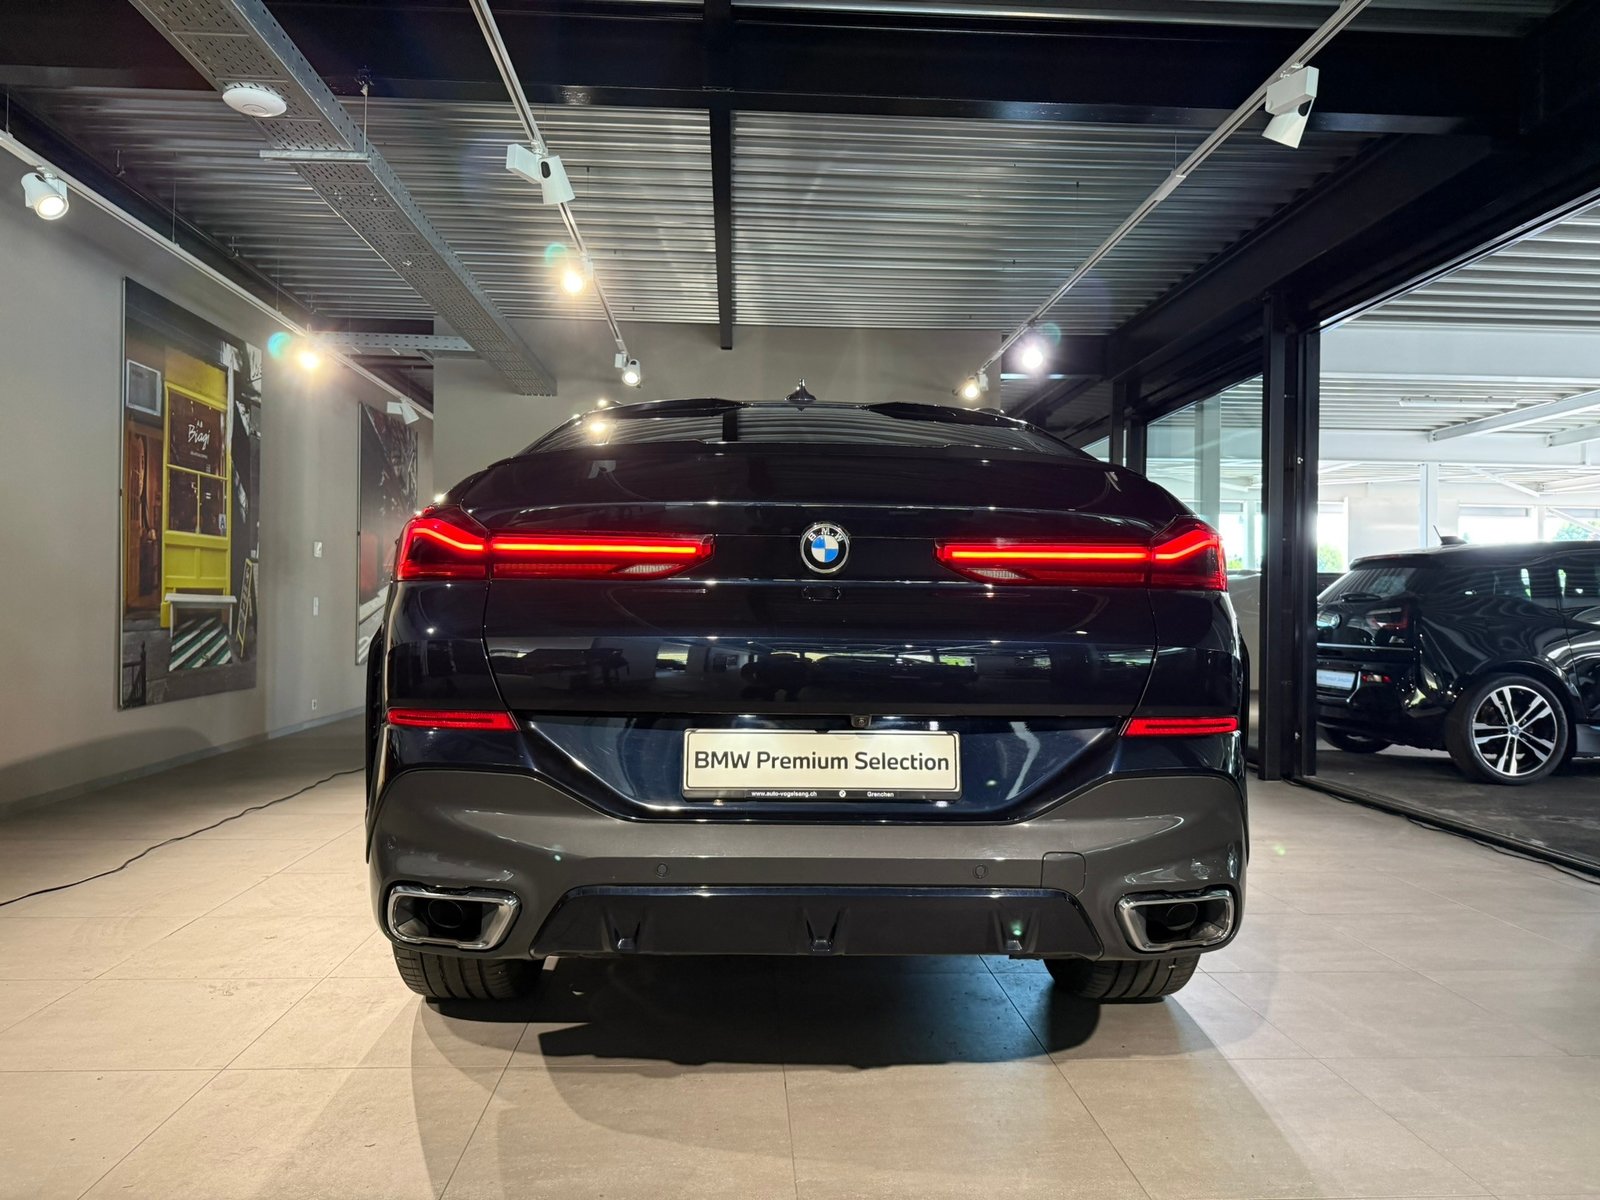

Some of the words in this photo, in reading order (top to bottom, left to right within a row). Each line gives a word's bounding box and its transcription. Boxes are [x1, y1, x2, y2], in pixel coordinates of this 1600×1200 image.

[188, 424, 210, 450] Biagi
[808, 527, 844, 542] BMW
[694, 751, 750, 769] BMW
[756, 751, 848, 770] Premium
[854, 752, 950, 771] Selection
[751, 790, 818, 798] www.auto-vogelsang.ch
